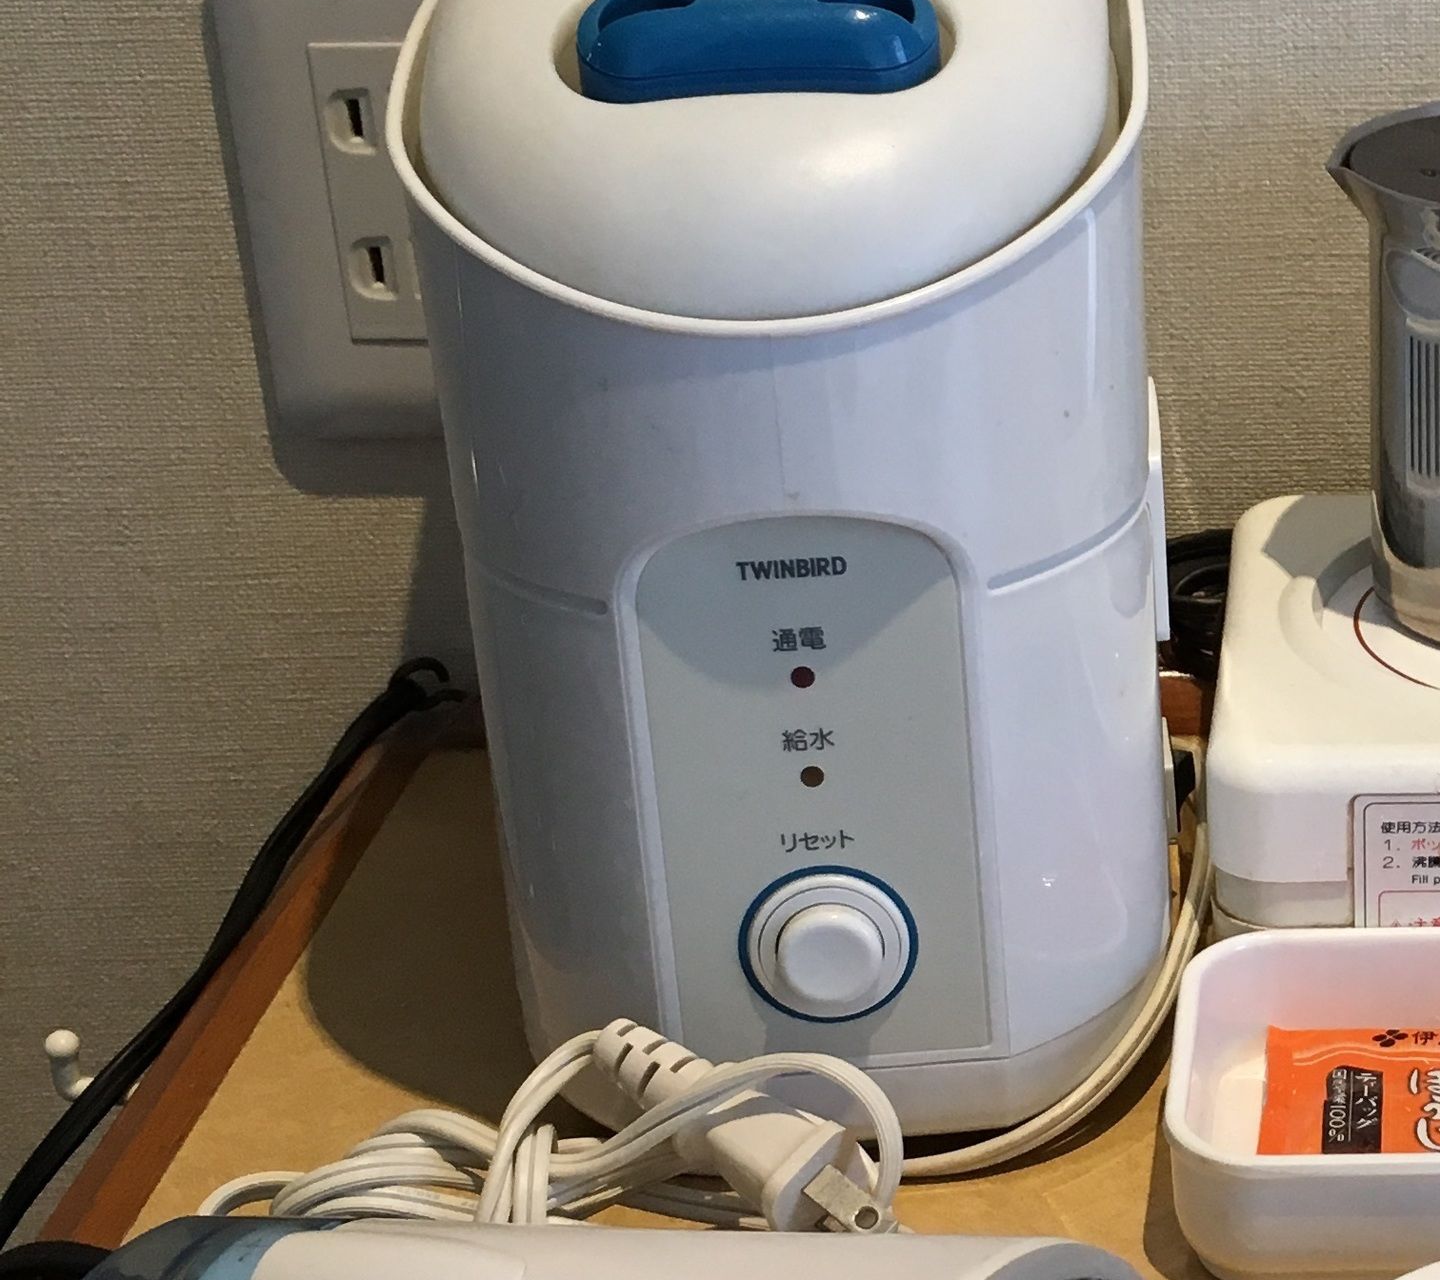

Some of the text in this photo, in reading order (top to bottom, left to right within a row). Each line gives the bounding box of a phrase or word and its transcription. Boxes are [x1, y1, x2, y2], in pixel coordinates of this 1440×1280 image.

[736, 556, 847, 581] TWINBIRD
[772, 627, 827, 651] 通電
[782, 728, 835, 753] 給水
[780, 830, 855, 853] リセット
[1411, 874, 1429, 884] Fill
[1354, 1071, 1378, 1131] ティーバッグ
